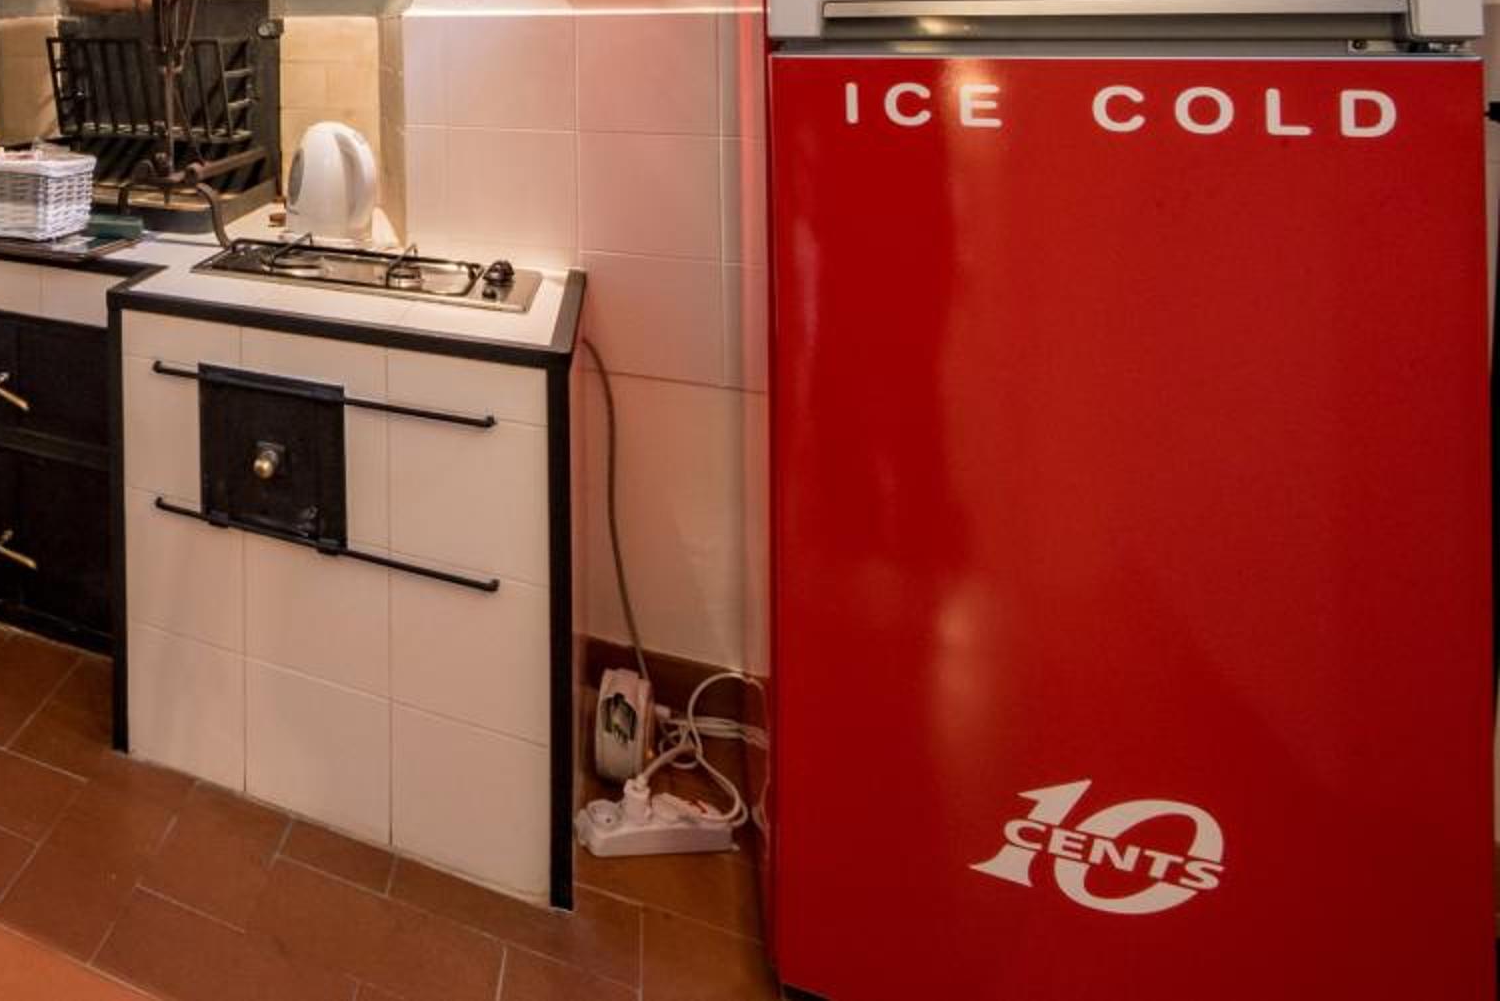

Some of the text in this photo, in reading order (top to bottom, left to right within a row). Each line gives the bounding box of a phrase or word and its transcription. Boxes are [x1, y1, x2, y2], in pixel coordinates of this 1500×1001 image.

[844, 82, 1398, 138] ICE COLD
[969, 778, 1224, 915] 10
[1003, 818, 1224, 890] CENTS
